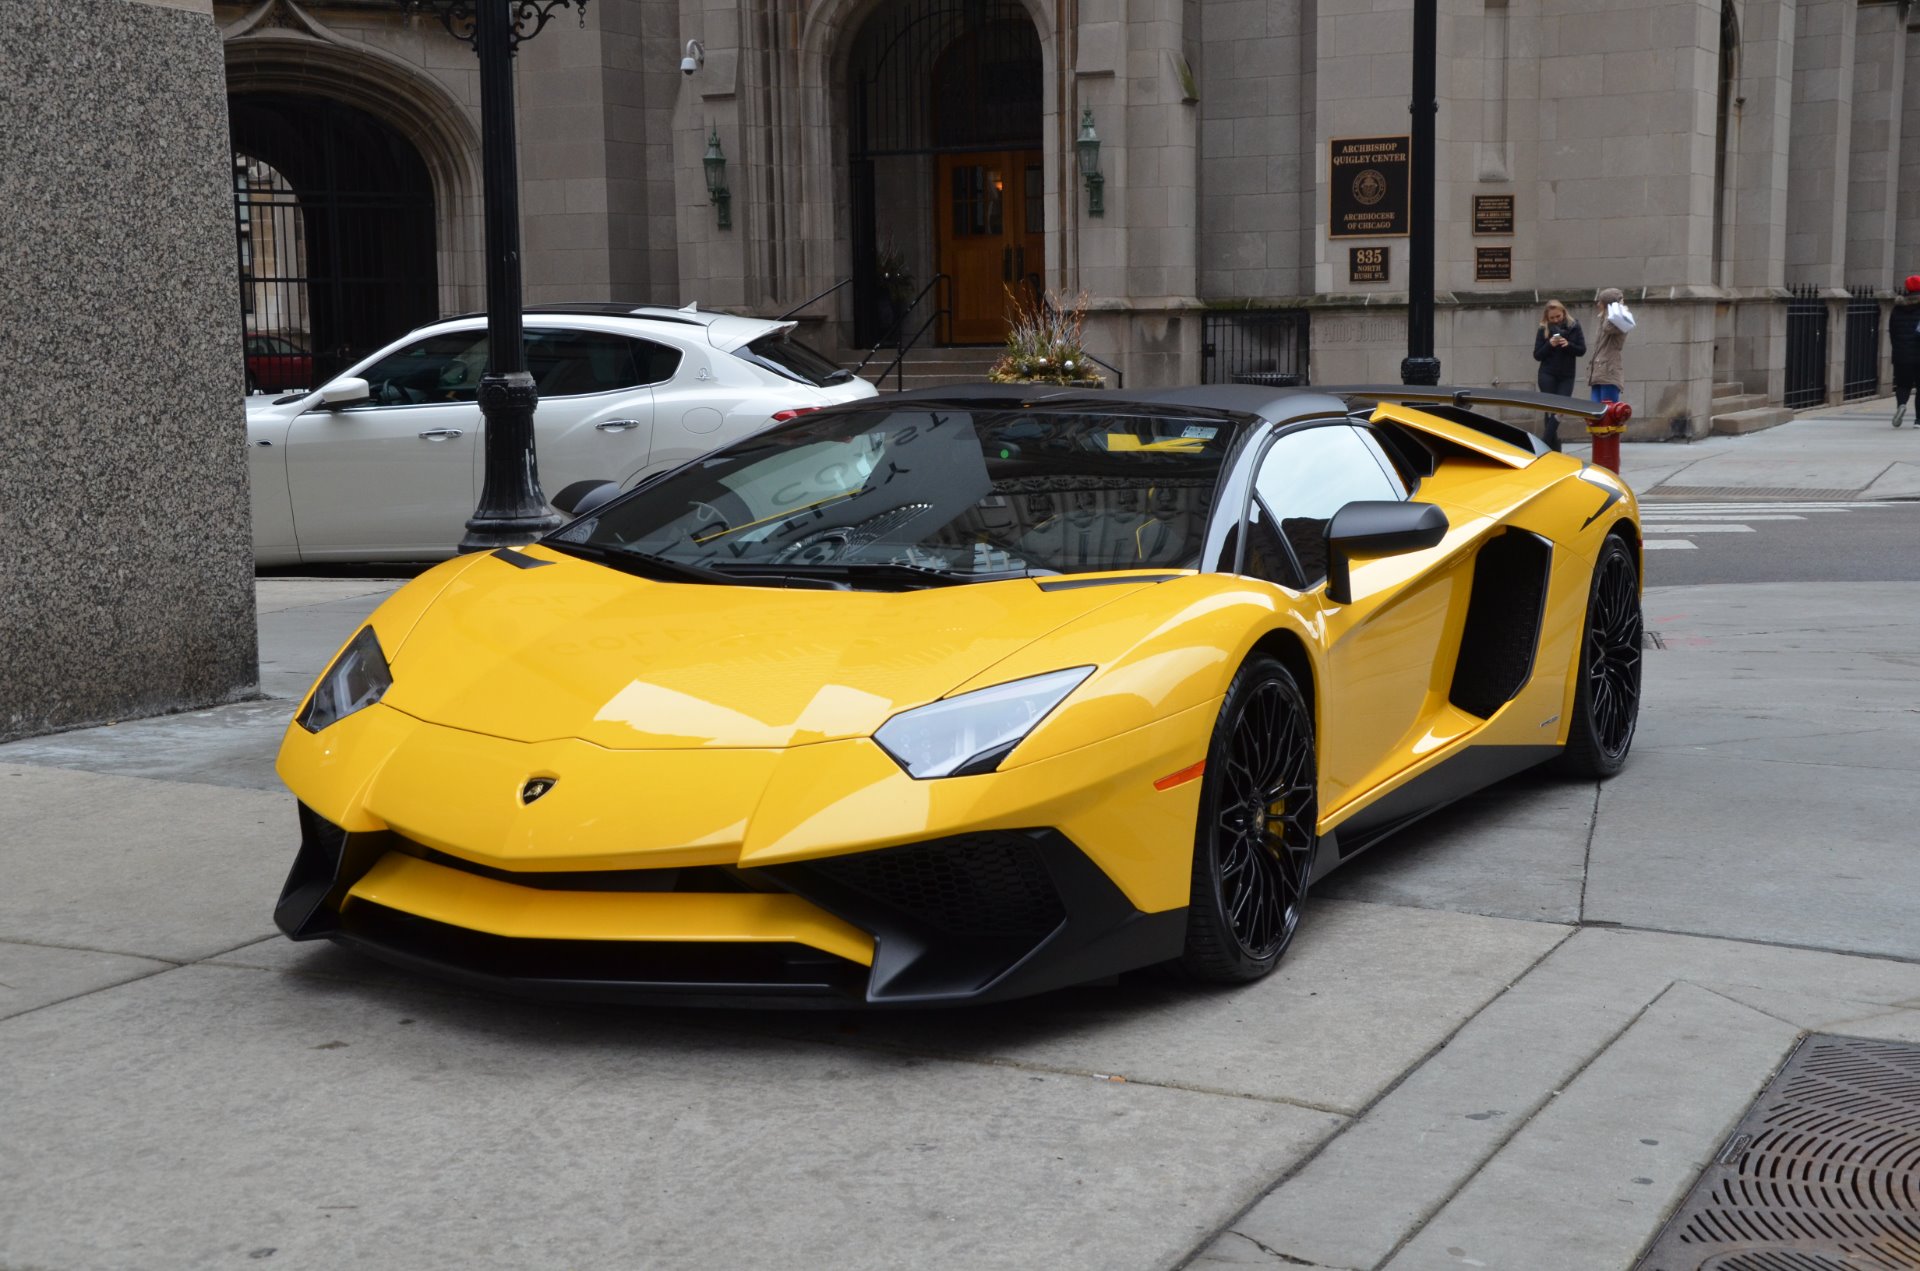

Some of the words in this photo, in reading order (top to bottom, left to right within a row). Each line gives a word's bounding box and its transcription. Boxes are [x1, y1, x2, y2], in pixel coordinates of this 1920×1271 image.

[1342, 143, 1397, 153] ARCHBISHOP
[1333, 155, 1371, 165] QUIGLEY
[1372, 153, 1406, 163] CENTER
[1343, 212, 1395, 221] ARCHDIOCESE
[1347, 222, 1357, 230] OF
[1358, 221, 1391, 230] CHICAGO
[1357, 249, 1382, 263] 835
